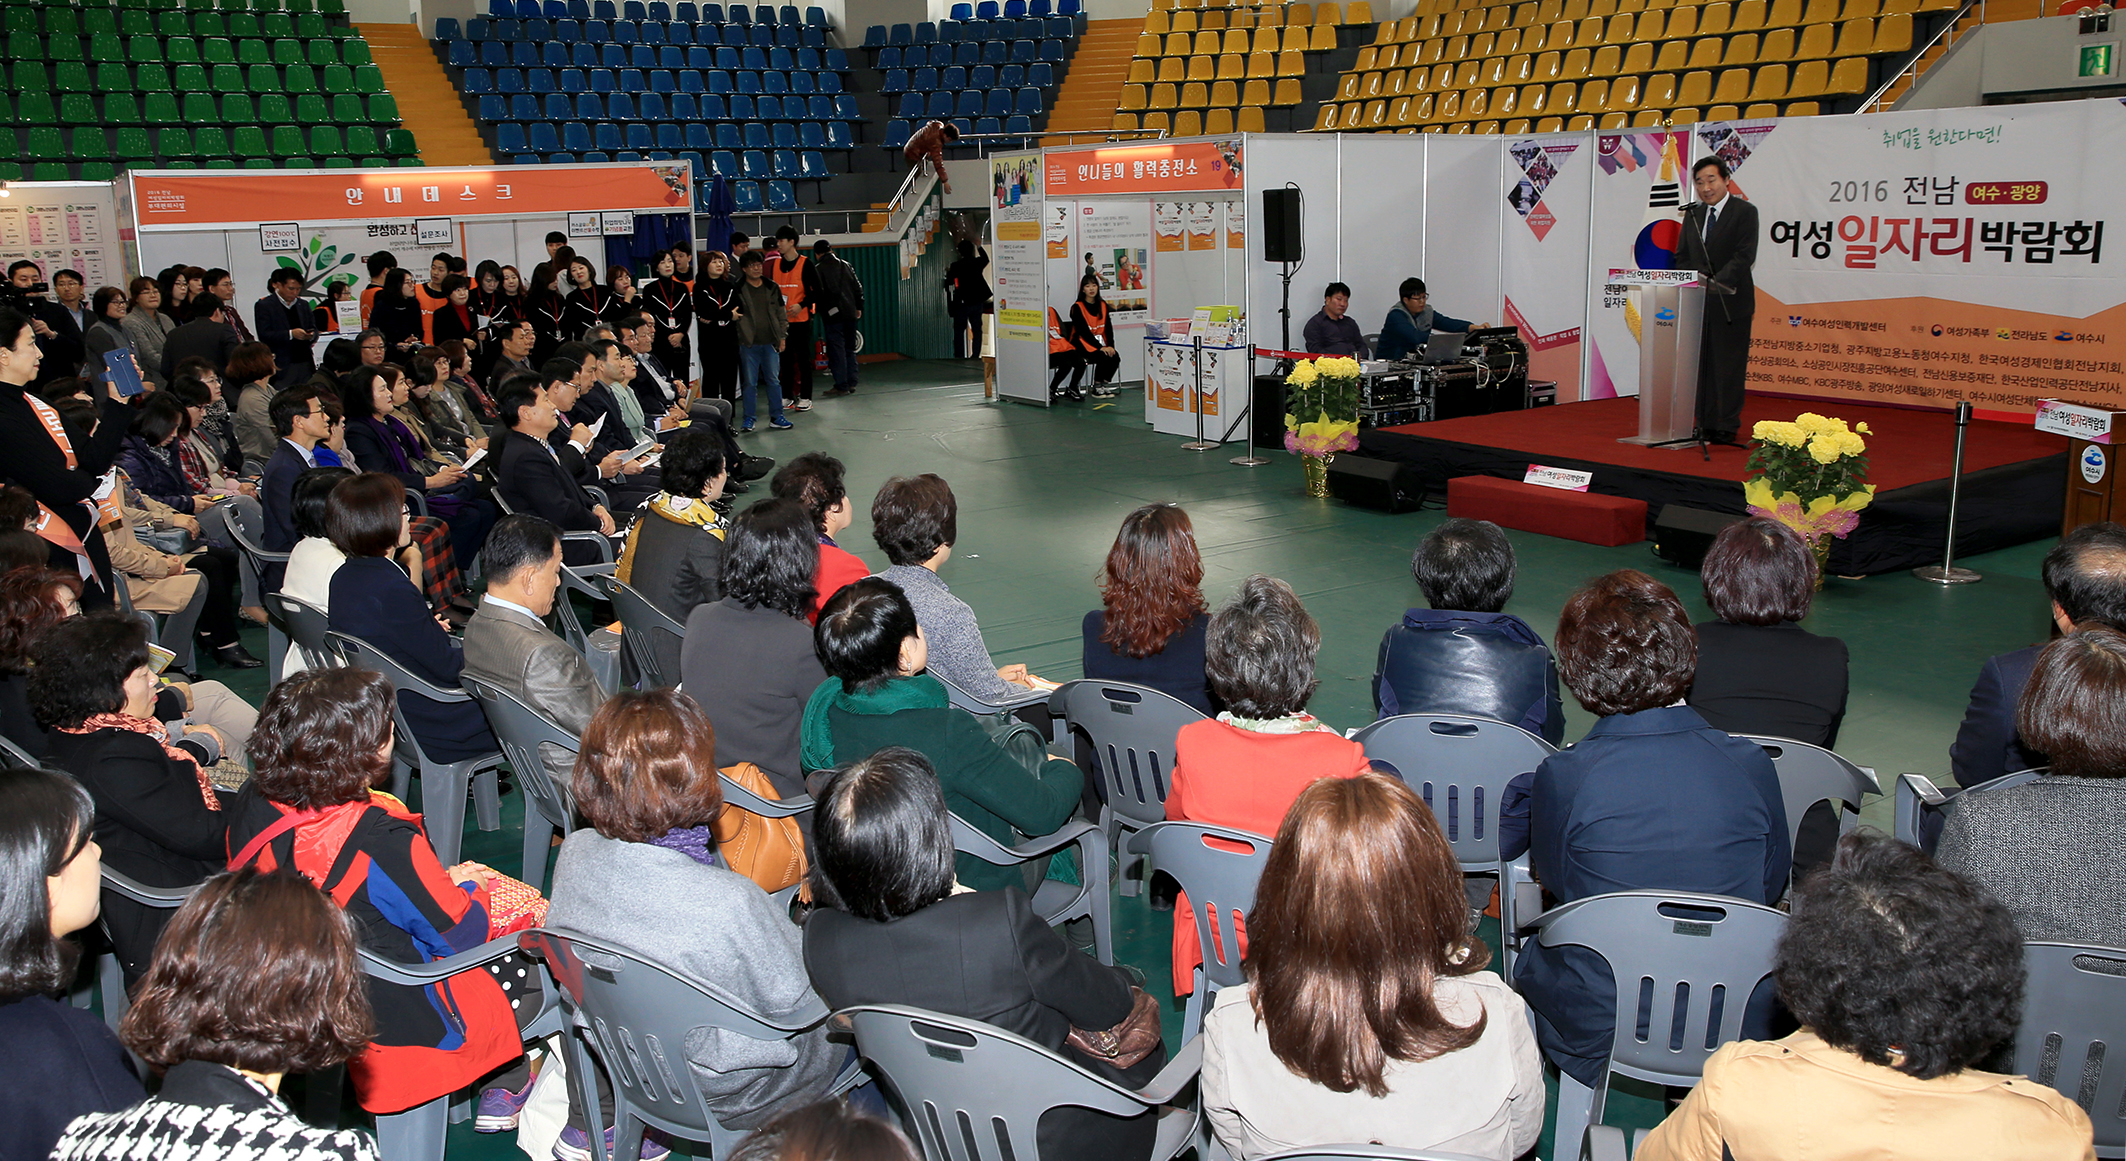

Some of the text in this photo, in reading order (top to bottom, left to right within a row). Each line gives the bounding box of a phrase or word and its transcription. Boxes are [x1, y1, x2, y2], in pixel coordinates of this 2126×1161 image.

[1883, 125, 2002, 150] 취업을 원한다면!
[1078, 158, 1222, 182] 언니들의 활력충전소 19
[1828, 180, 1888, 203] 2016
[1903, 175, 1960, 206] 전남
[265, 239, 296, 247] 사전접수
[421, 230, 448, 239] 설문조사
[1770, 214, 2104, 269] 여성일자리박람회
[1802, 318, 1887, 332] 여수여성인력개발센터
[1947, 327, 1990, 338] 여성가족부
[2011, 330, 2047, 341] 전라남도
[2076, 333, 2105, 344] 여수시
